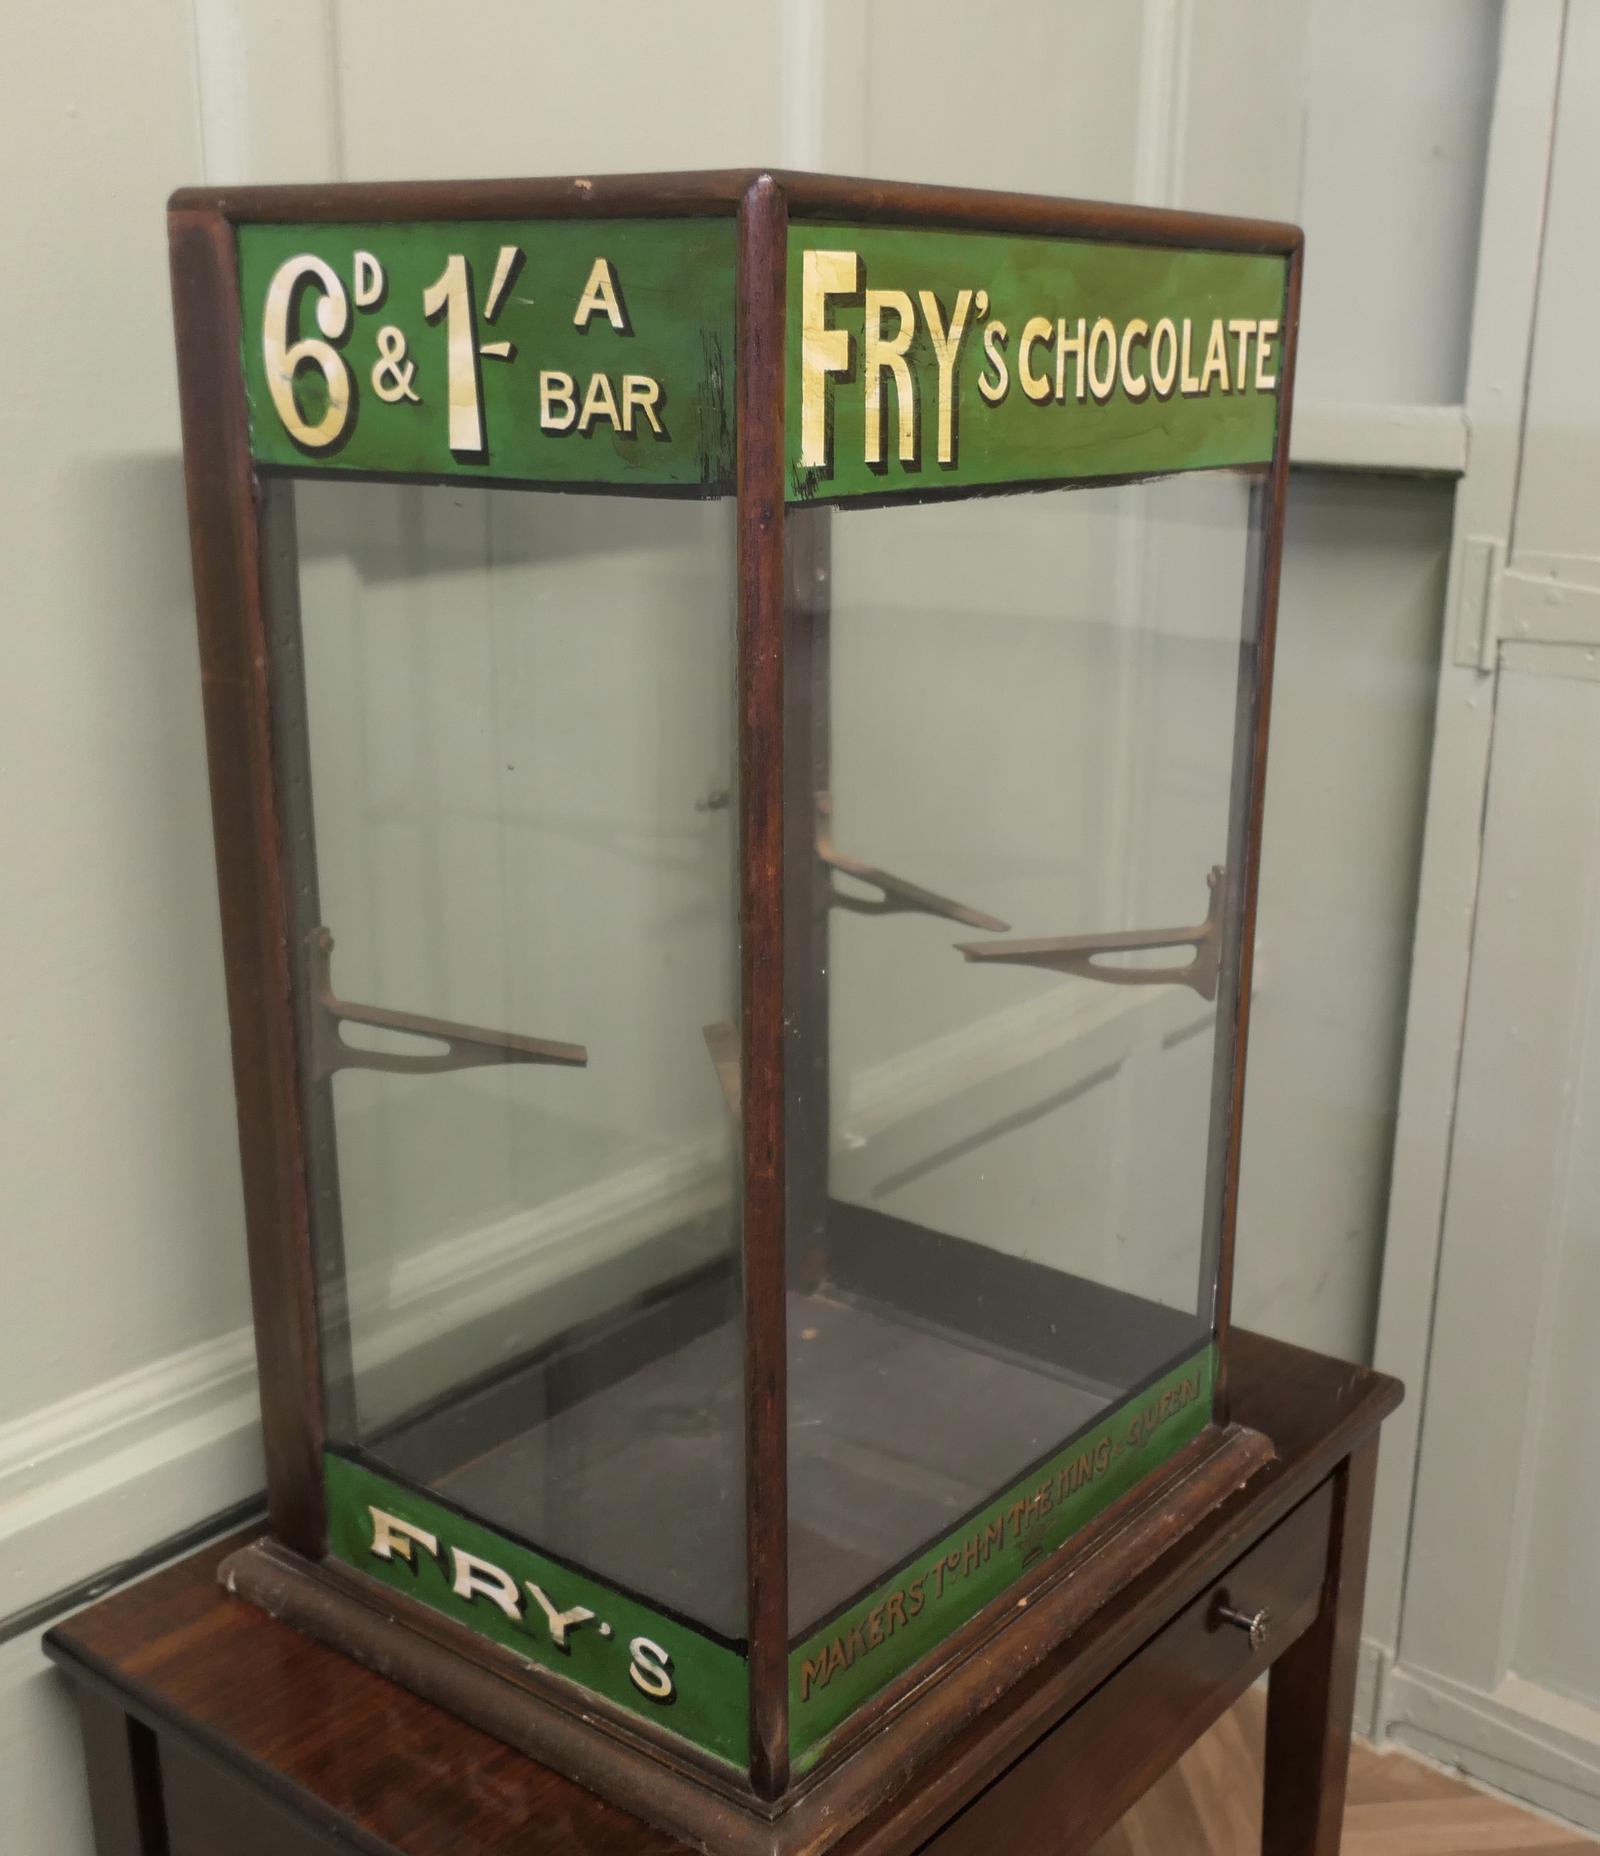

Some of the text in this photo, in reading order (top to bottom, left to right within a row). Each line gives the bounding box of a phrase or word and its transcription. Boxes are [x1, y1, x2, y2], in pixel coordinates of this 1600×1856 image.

[573, 257, 625, 329] A
[371, 325, 420, 403] &
[1017, 316, 1279, 400] CHOCOLATE
[539, 370, 663, 434] BAR
[801, 1576, 926, 1703] MAKERS
[1008, 1480, 1054, 1537] THE
